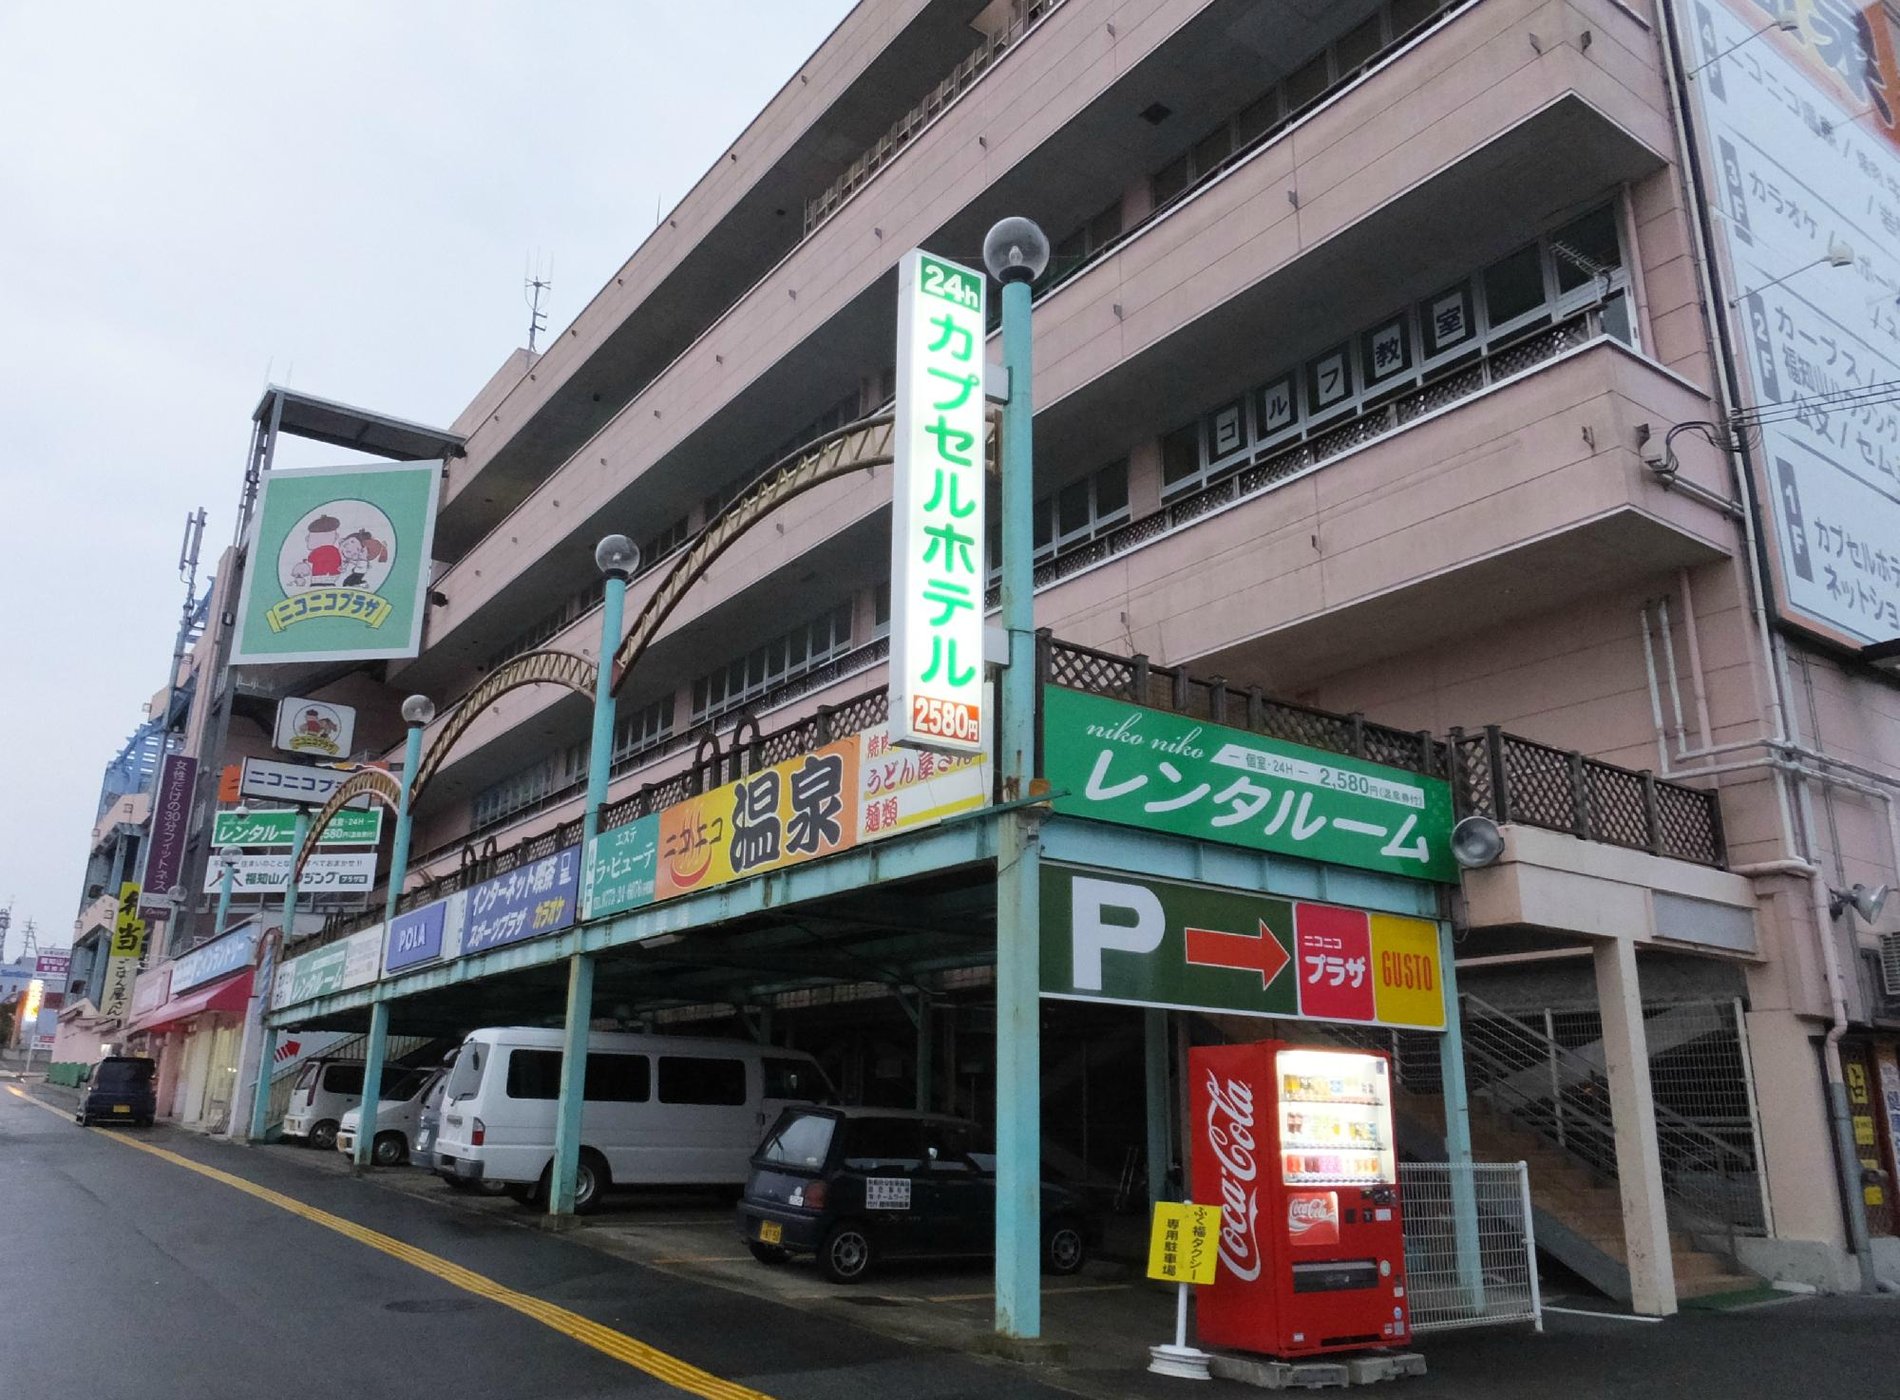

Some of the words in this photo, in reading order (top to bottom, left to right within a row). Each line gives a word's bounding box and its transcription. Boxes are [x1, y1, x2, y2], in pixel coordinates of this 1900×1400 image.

[1749, 170, 1818, 240] カラオケ
[924, 264, 979, 309] 24h
[1753, 312, 1771, 379] 2F
[1775, 306, 1862, 386] カーブス
[1791, 390, 1835, 444] 公文
[921, 314, 980, 687] カプセルホテル
[1785, 484, 1802, 555] 1F
[278, 593, 380, 623] ニコニコプラザ
[914, 696, 979, 741] 2580円
[1087, 712, 1143, 745] niko
[1151, 727, 1203, 758] niko
[664, 817, 723, 859] ニコニコ
[729, 753, 843, 875] 温泉
[1085, 749, 1430, 863] レンタルーム
[218, 825, 296, 842] レンタルー
[615, 827, 637, 846] エステ
[398, 923, 426, 952] POLA
[1072, 876, 1166, 991] P
[1304, 935, 1342, 950] ニコニコ
[1305, 953, 1366, 988] プラザ
[1382, 950, 1433, 992] GUSTO
[1162, 1218, 1180, 1276] 専用駐車場
[1189, 1207, 1208, 1280] ふく福タクシー
